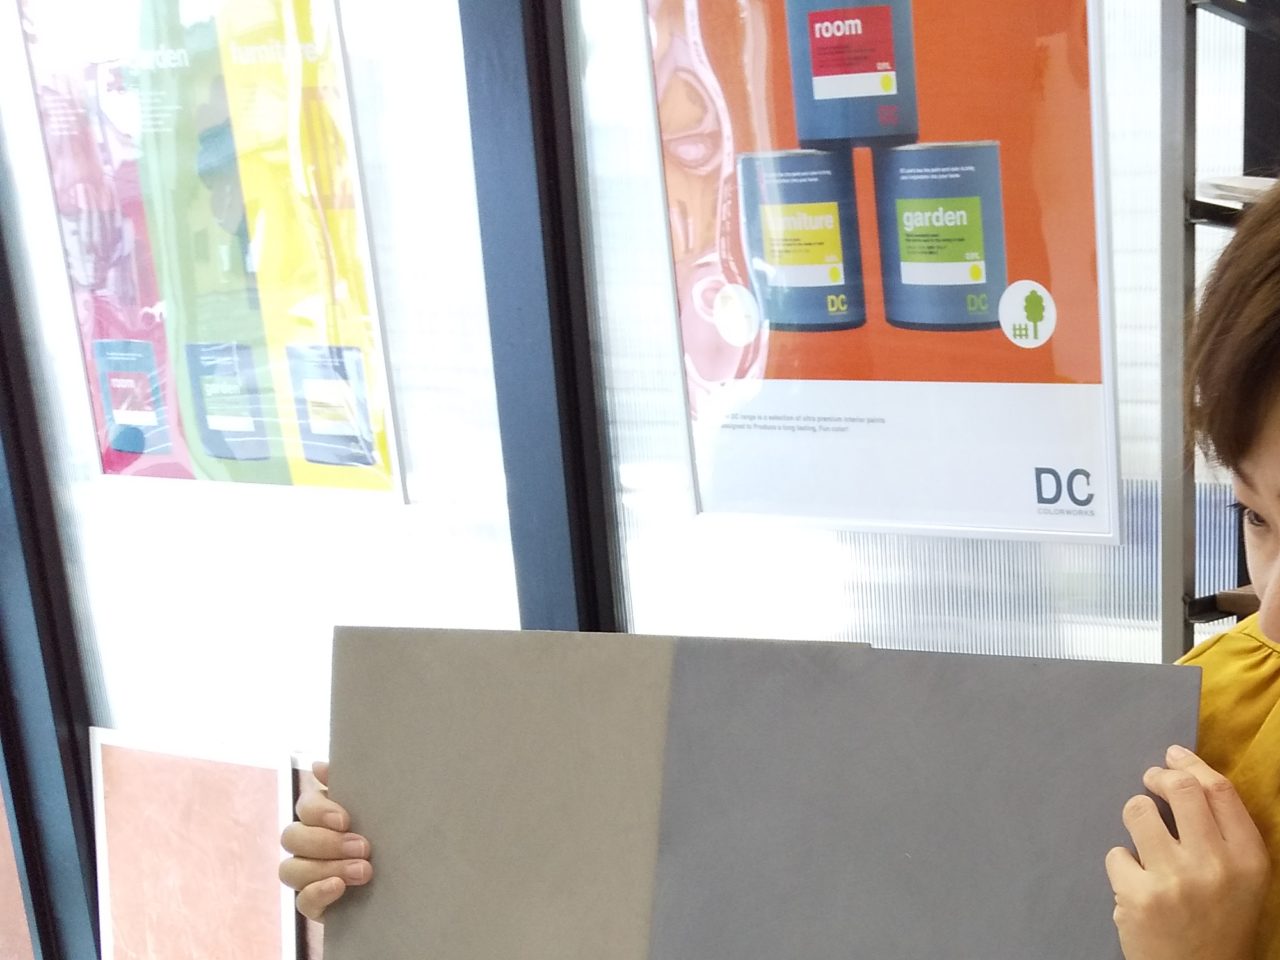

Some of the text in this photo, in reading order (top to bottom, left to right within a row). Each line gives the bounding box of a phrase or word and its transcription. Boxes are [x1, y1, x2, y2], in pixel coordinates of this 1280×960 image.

[814, 18, 863, 38] room
[902, 206, 968, 232] garden
[827, 294, 848, 312] DC
[1034, 467, 1095, 506] DC
